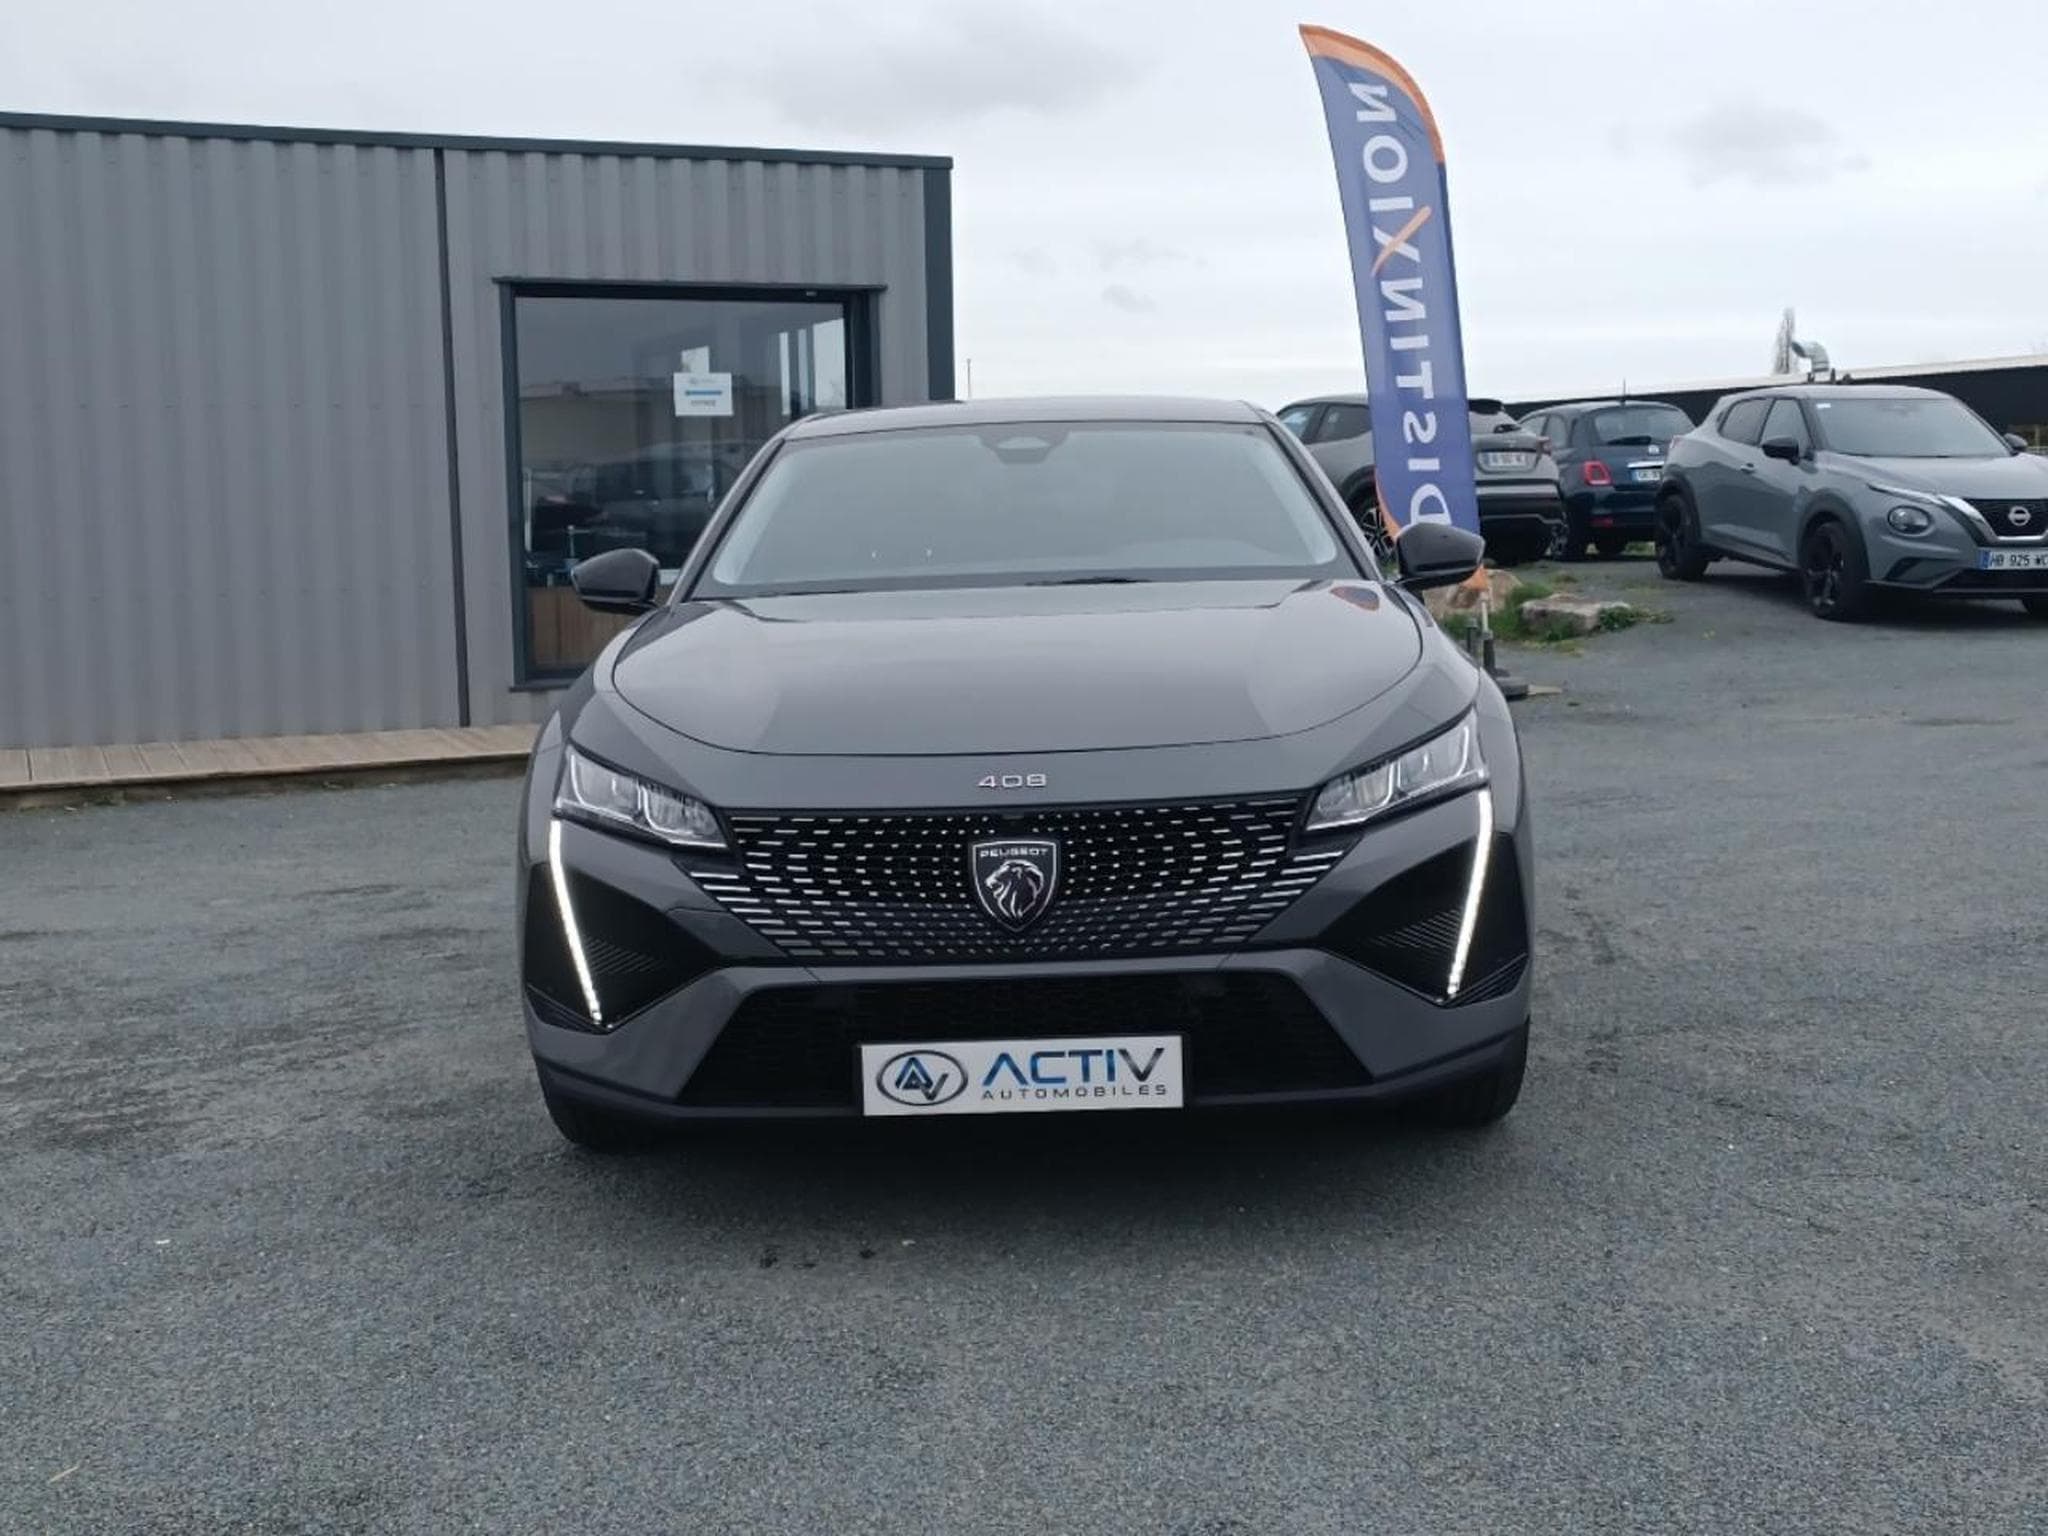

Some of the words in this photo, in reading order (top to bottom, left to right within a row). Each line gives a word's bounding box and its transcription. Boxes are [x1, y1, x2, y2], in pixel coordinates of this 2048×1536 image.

[978, 773, 1047, 788] 408
[980, 846, 1049, 858] PEUGEOT
[982, 1047, 1165, 1087] ACTIV
[982, 1084, 1168, 1101] AUTOMOBILES
